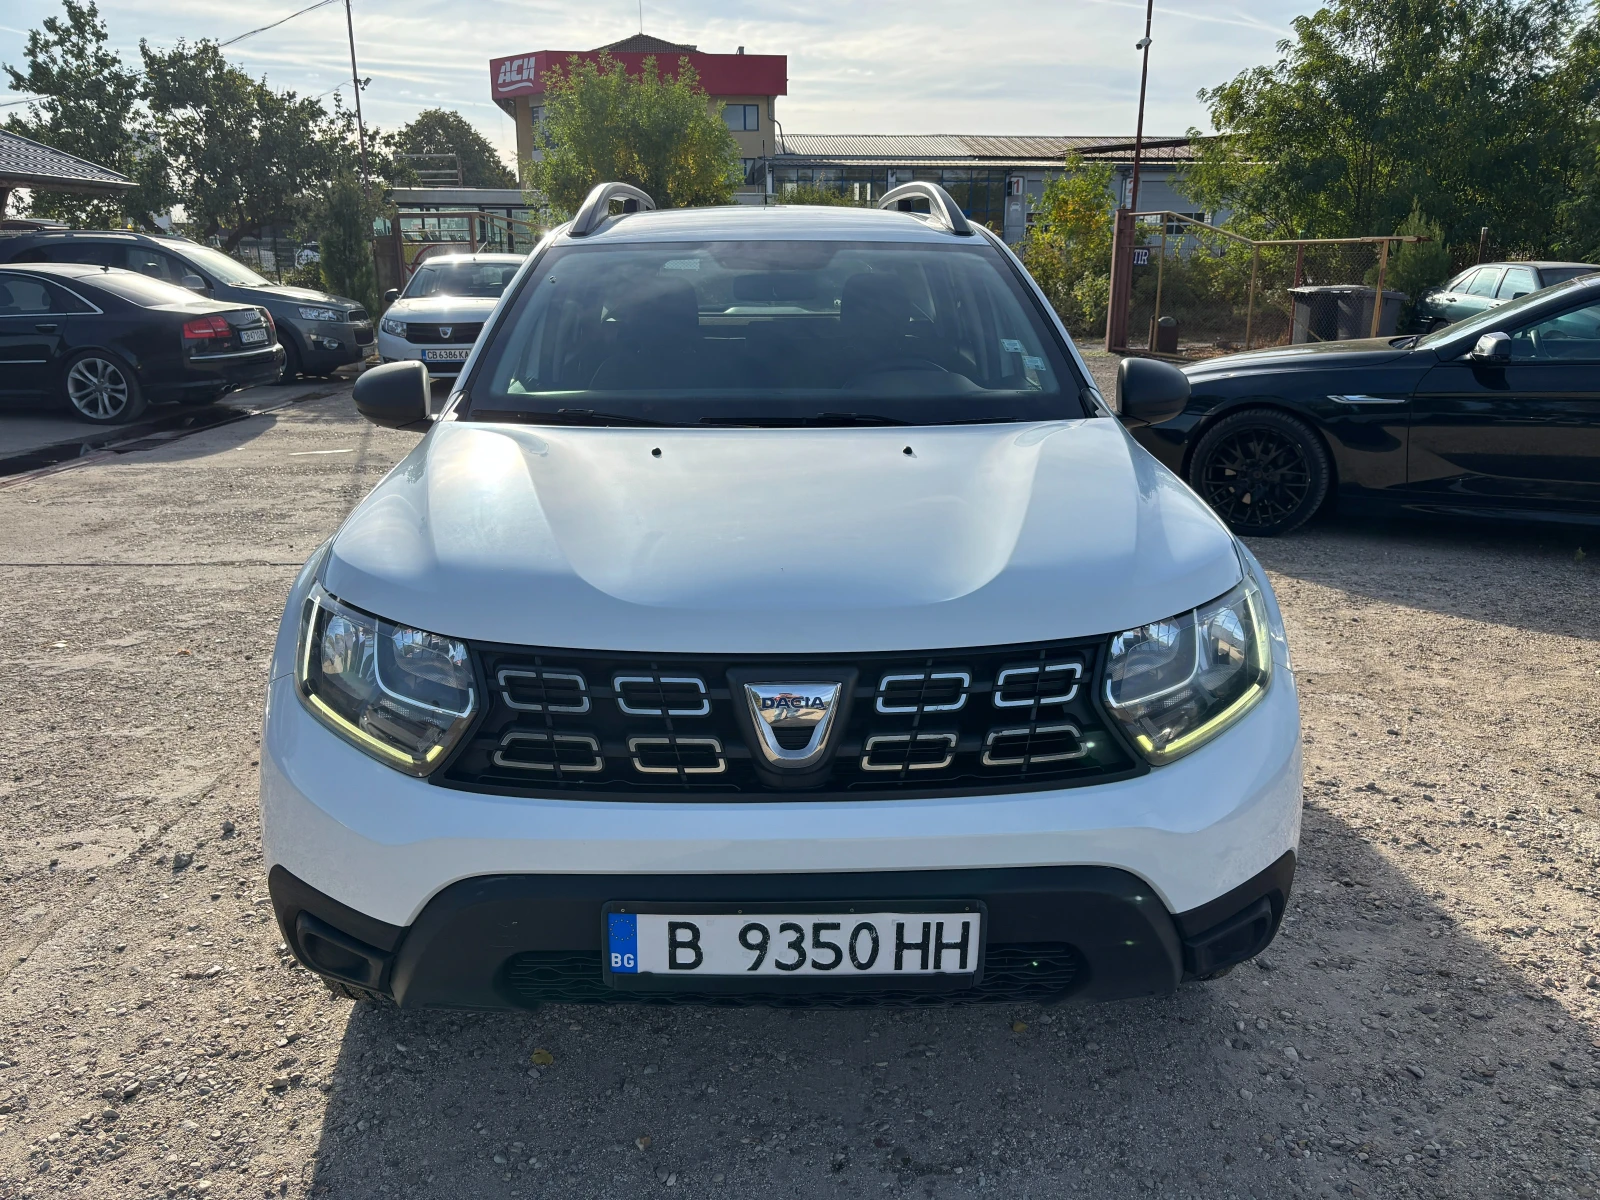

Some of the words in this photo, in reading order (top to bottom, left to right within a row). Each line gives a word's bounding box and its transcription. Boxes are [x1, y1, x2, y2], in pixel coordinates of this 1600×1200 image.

[1014, 179, 1020, 193] 1
[1134, 249, 1149, 264] TIR
[427, 351, 438, 359] CB
[439, 351, 458, 359] 6386
[458, 351, 469, 359] KA
[761, 696, 825, 709] DACIA
[667, 920, 704, 970] B
[737, 920, 880, 972] 9350
[893, 920, 971, 971] HH
[610, 952, 635, 968] BG
